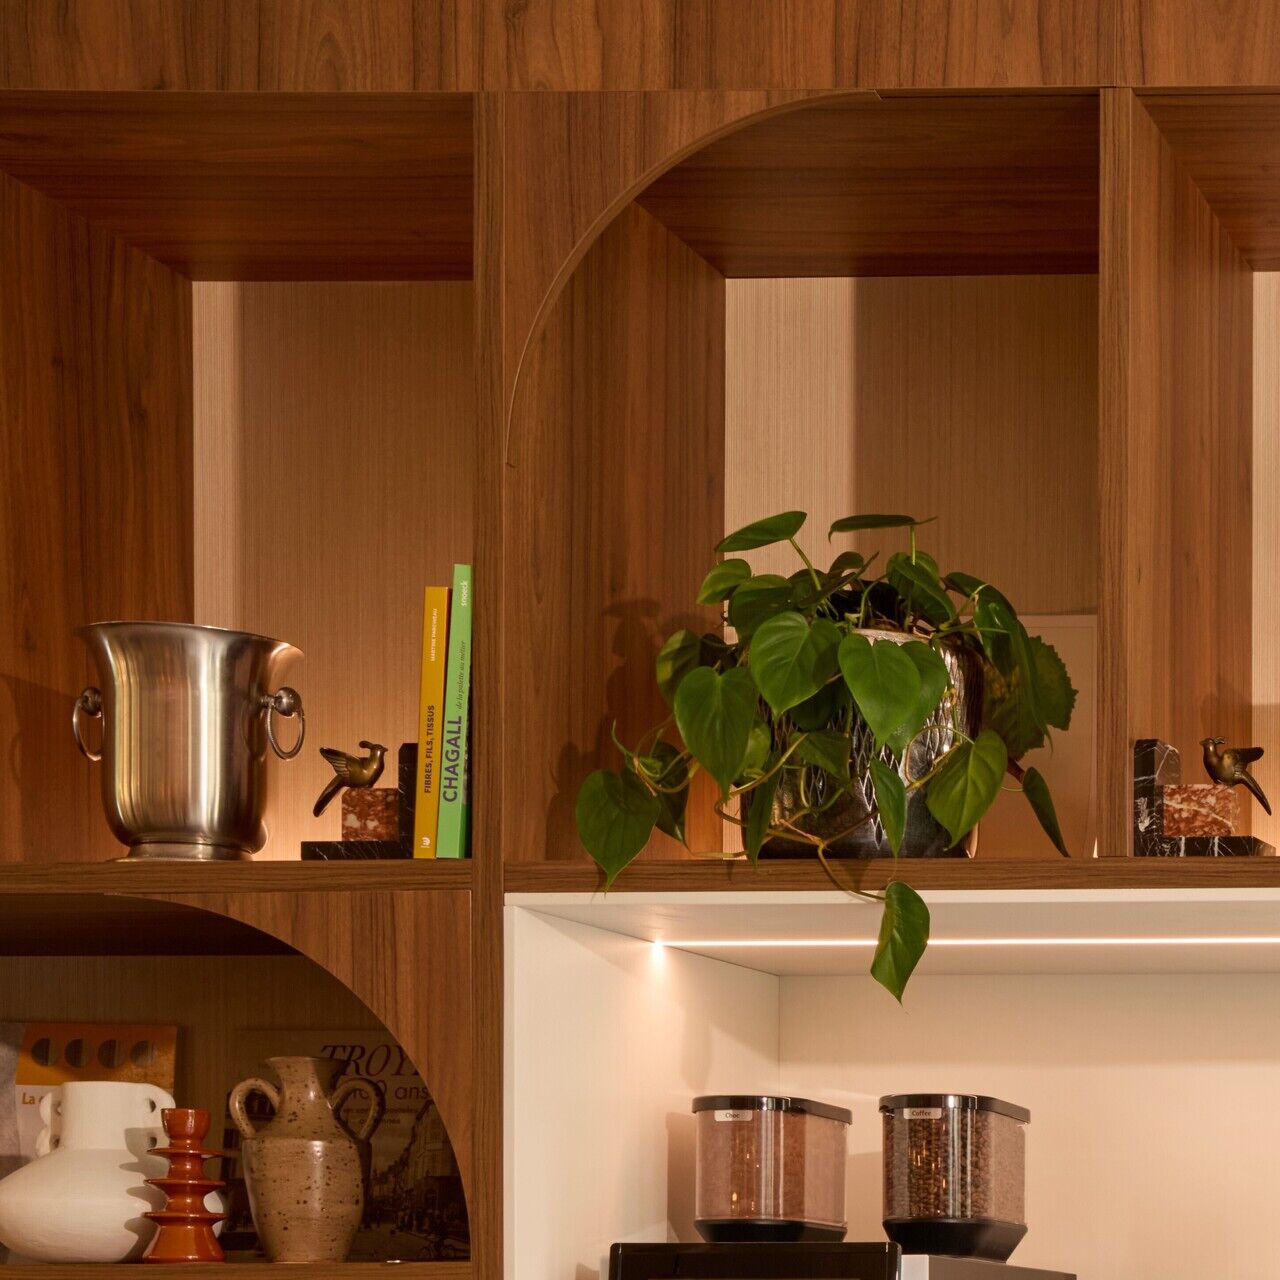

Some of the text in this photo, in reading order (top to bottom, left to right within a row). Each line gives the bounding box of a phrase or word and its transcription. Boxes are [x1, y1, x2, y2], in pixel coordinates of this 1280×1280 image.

[424, 705, 435, 794] FIBRES, FILS, TISSUS
[443, 716, 462, 803] CHAGALL
[320, 1044, 420, 1077] TROY
[22, 1092, 35, 1105] La
